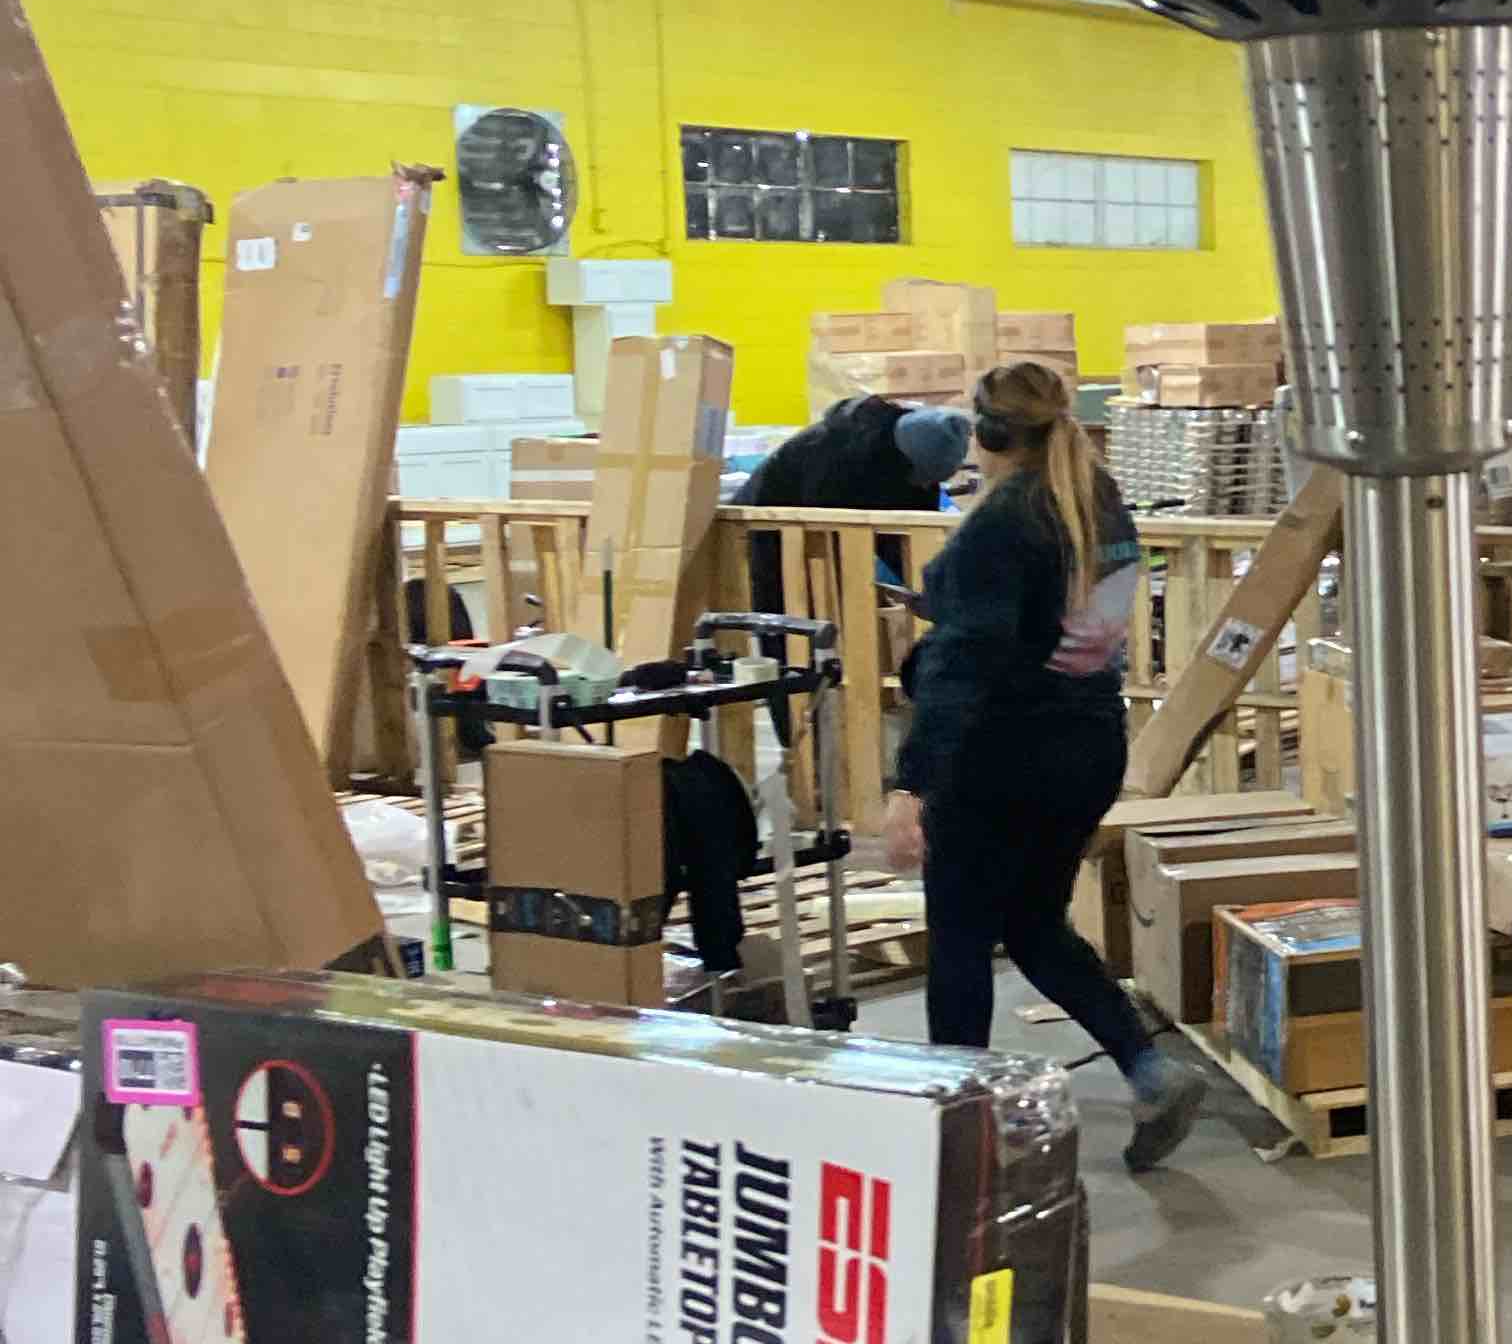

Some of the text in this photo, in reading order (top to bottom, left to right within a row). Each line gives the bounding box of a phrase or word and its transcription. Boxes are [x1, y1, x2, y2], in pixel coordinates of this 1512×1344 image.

[367, 1072, 389, 1122] LED
[363, 1126, 389, 1193] Light
[648, 1136, 667, 1188] With
[365, 1196, 388, 1234] Up
[646, 1193, 665, 1314] Automatic
